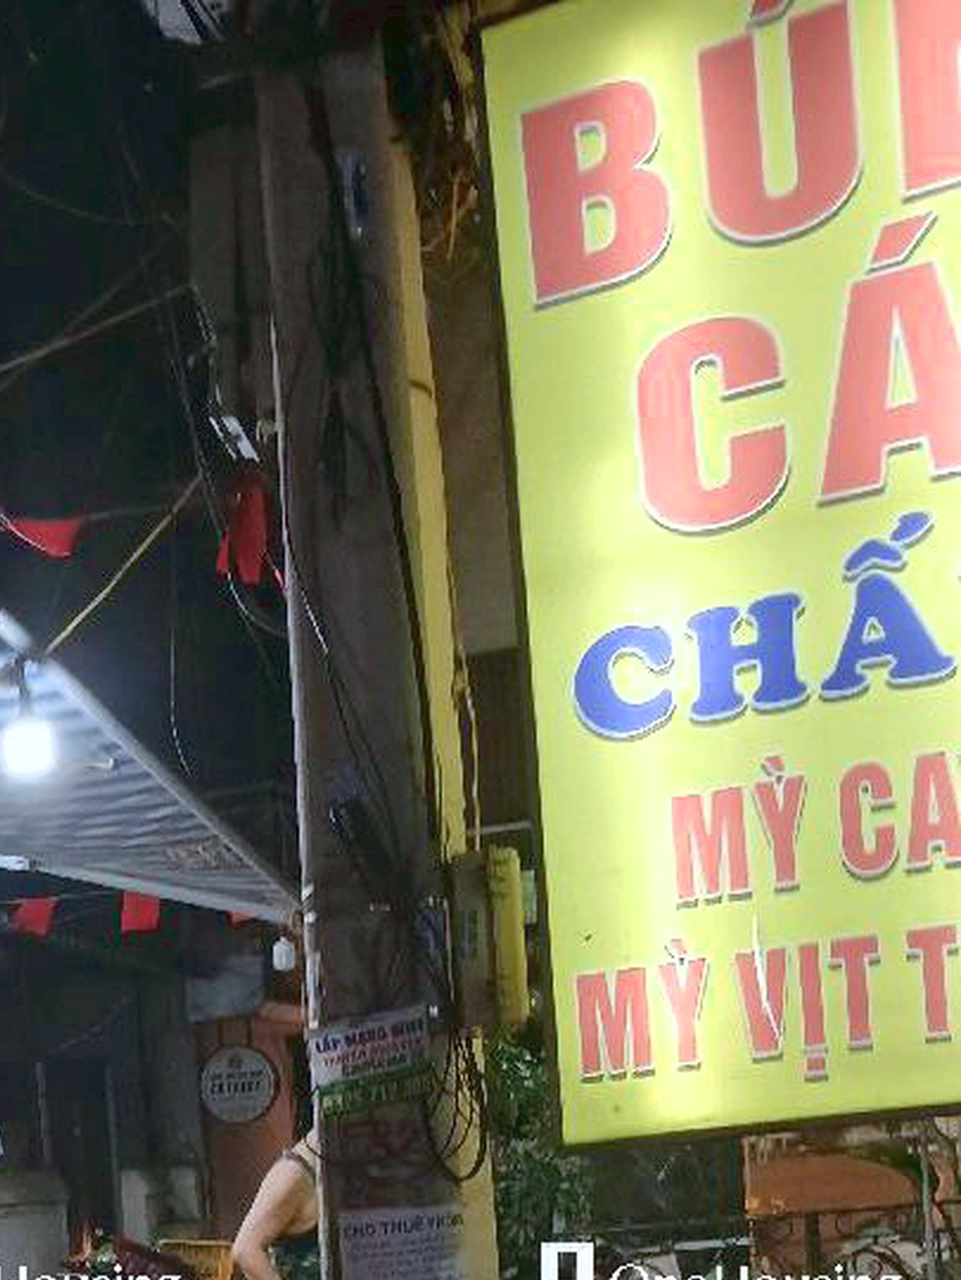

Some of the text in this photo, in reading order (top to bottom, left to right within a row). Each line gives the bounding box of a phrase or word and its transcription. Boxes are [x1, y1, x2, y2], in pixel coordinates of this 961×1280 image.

[636, 212, 961, 538] CÁ
[572, 511, 961, 741] CHẤ
[671, 751, 961, 909] MỲ CA
[576, 938, 709, 1083] MỲ
[735, 933, 881, 1081] VỊT
